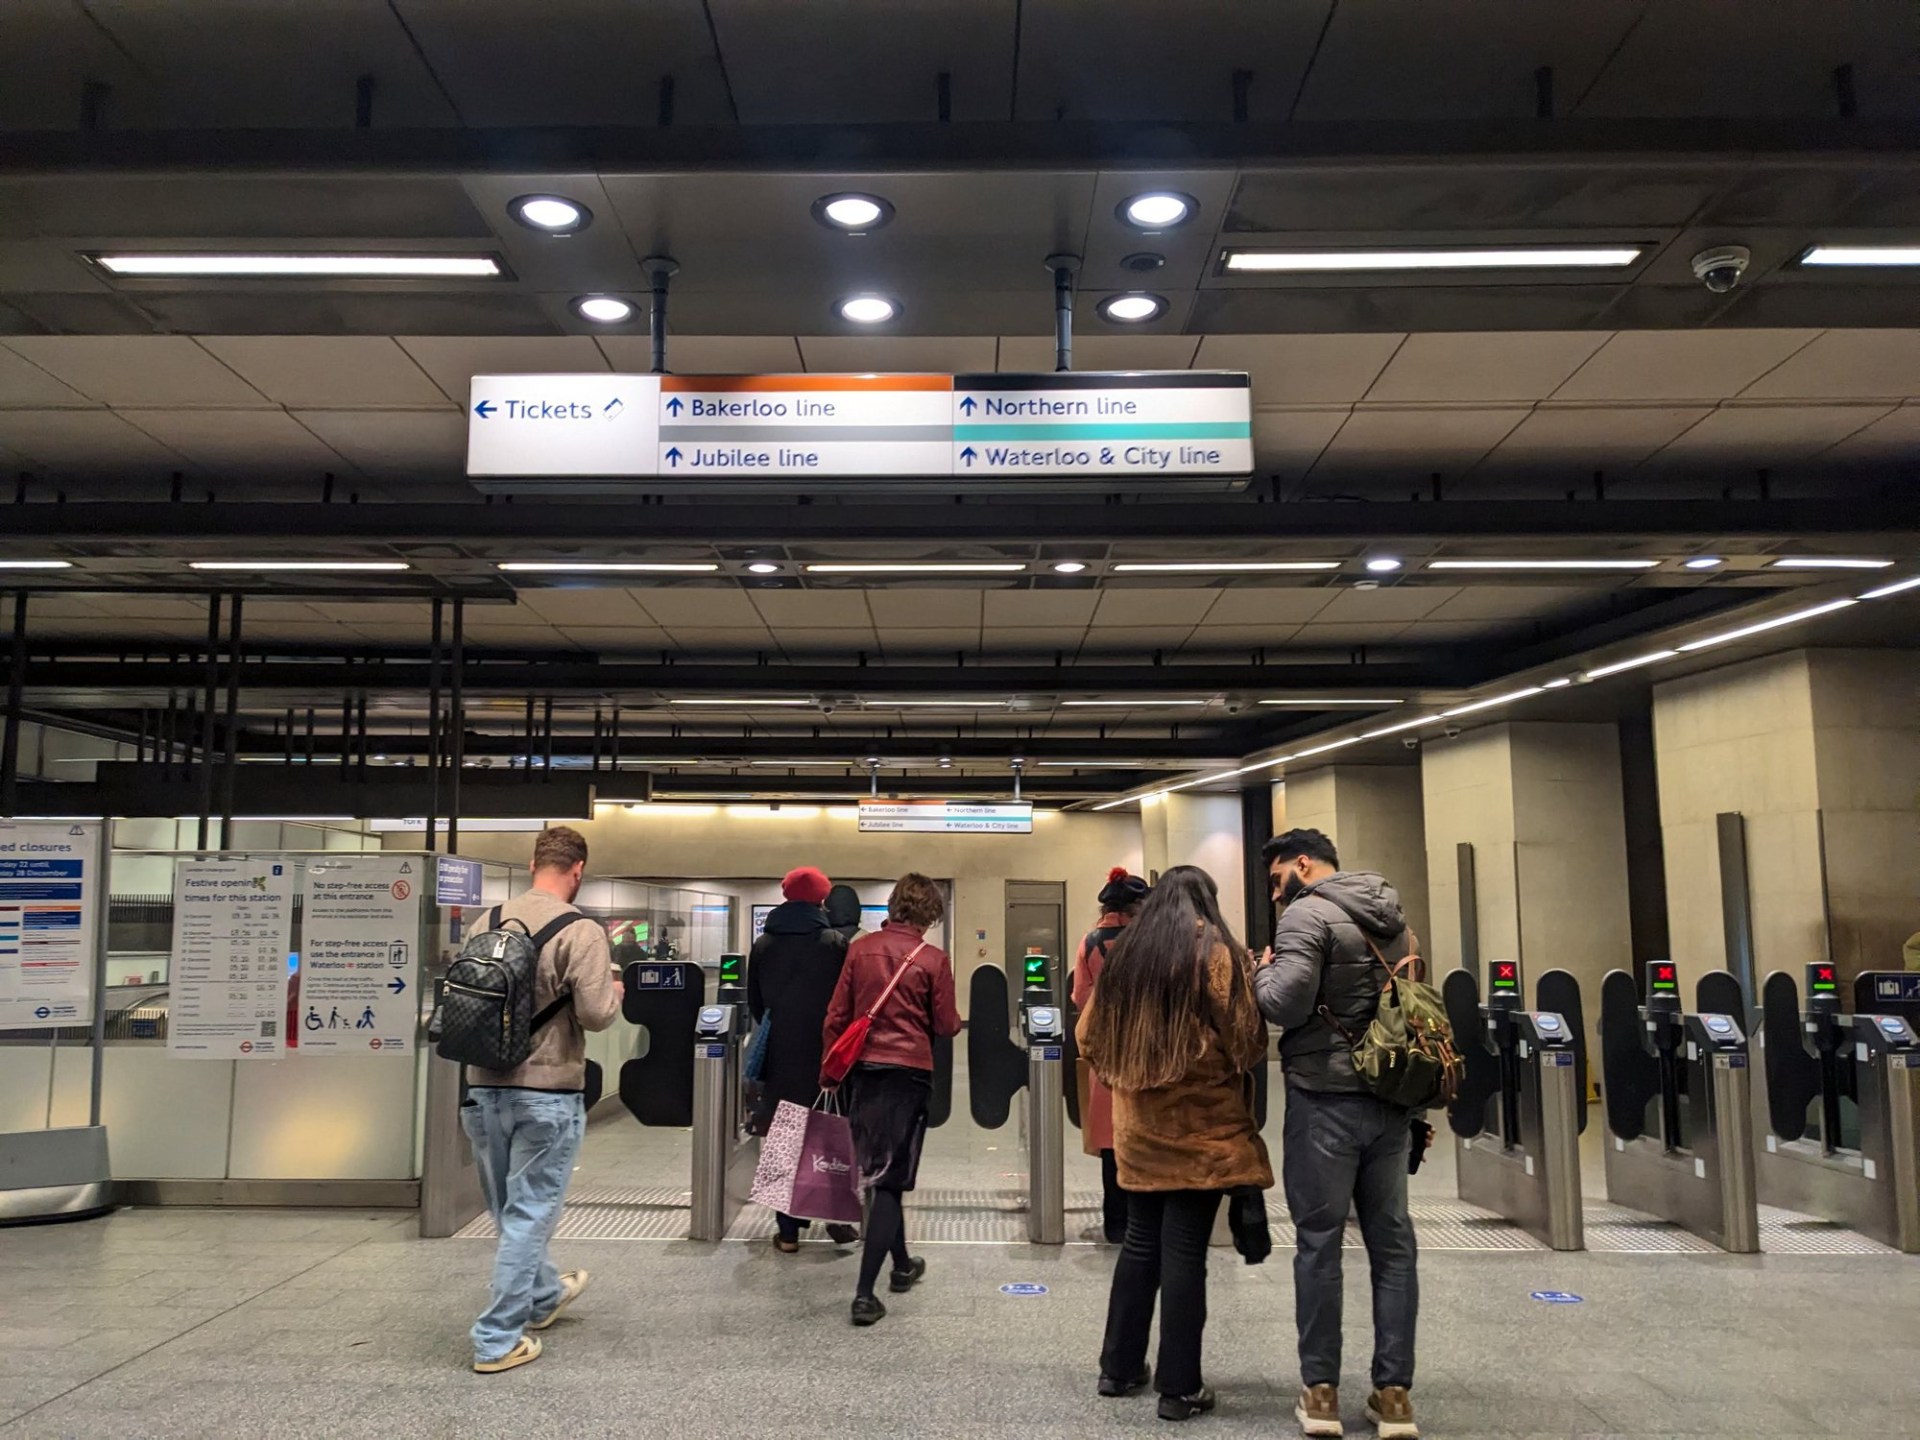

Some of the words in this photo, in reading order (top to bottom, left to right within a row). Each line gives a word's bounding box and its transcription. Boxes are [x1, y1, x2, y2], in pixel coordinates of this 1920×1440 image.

[505, 399, 592, 419] Tickets
[691, 399, 787, 417] Bakerloo
[796, 399, 836, 417] line
[985, 398, 1088, 416] Northern
[1097, 397, 1137, 415] line
[690, 449, 770, 467] Jubilee
[779, 449, 819, 467] line
[985, 448, 1090, 466] Waterloo
[1099, 447, 1114, 465] &
[1124, 446, 1171, 469] City
[1179, 446, 1221, 465] line
[20, 843, 72, 852] closures
[186, 879, 218, 888] Festive
[327, 882, 362, 890] step-free
[185, 894, 210, 902] times
[213, 894, 226, 902] for
[229, 894, 247, 902] this
[249, 894, 281, 902] station
[325, 940, 360, 948] step-free
